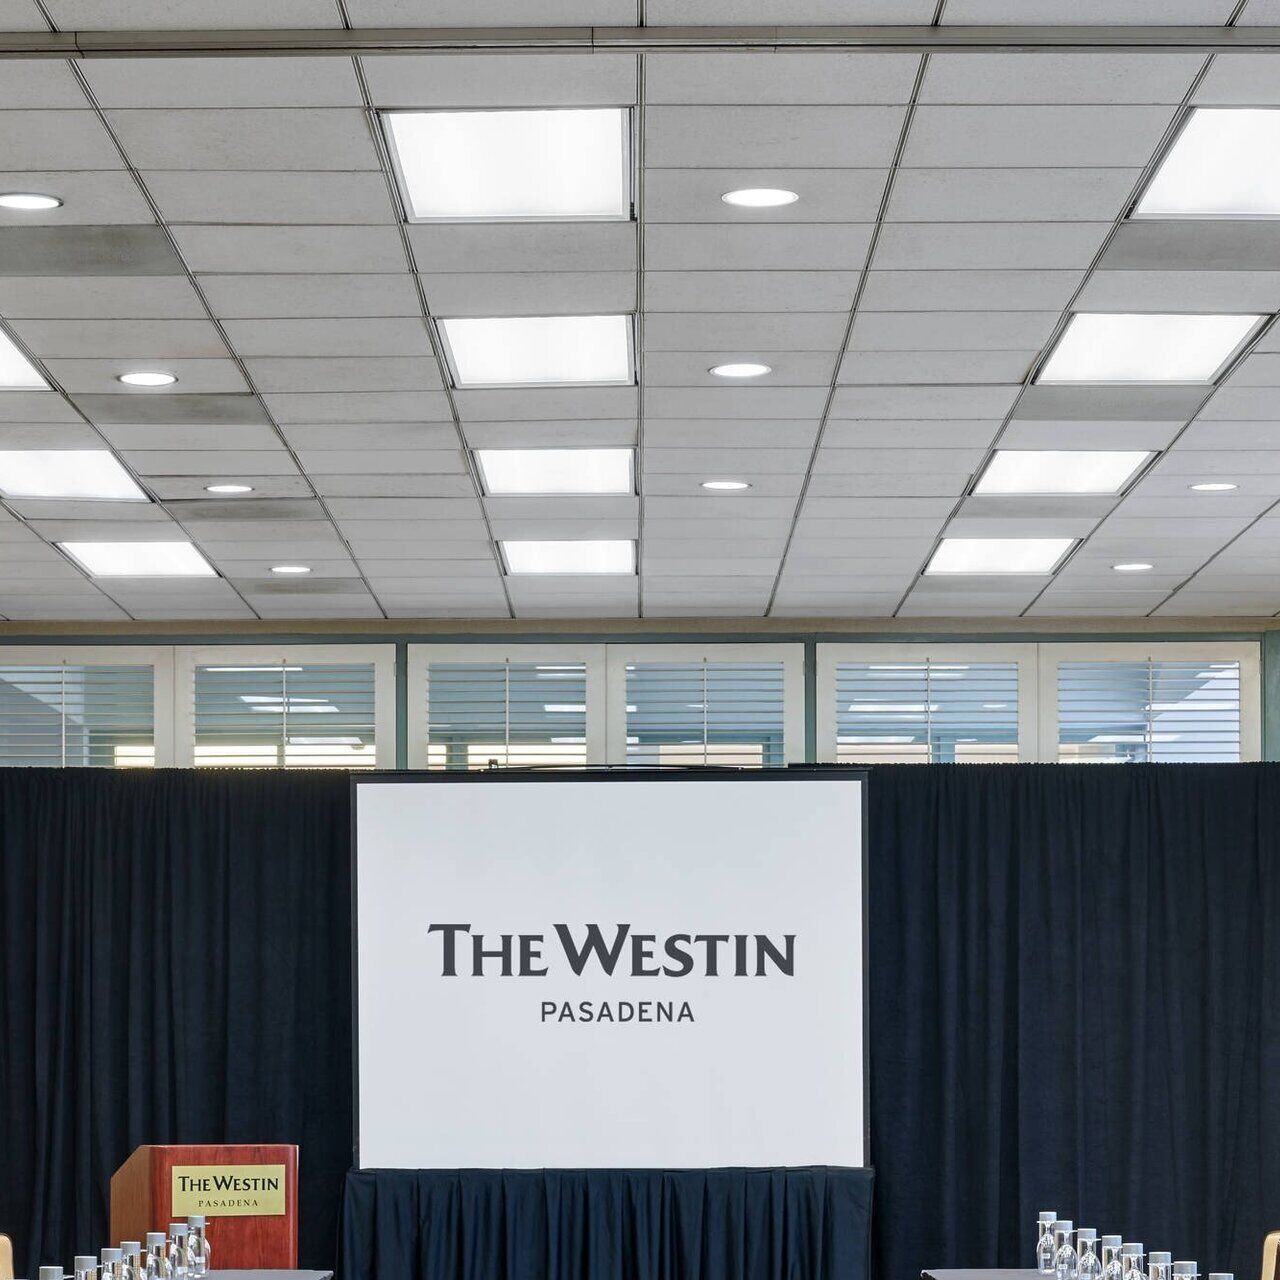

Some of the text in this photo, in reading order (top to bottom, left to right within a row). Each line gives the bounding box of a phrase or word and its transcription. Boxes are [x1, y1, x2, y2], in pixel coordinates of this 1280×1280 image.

[427, 923, 797, 978] THE WESTIN
[540, 1001, 695, 1023] PASADENA
[178, 1175, 279, 1192] THE WESTIN
[198, 1199, 258, 1208] PASADENA
